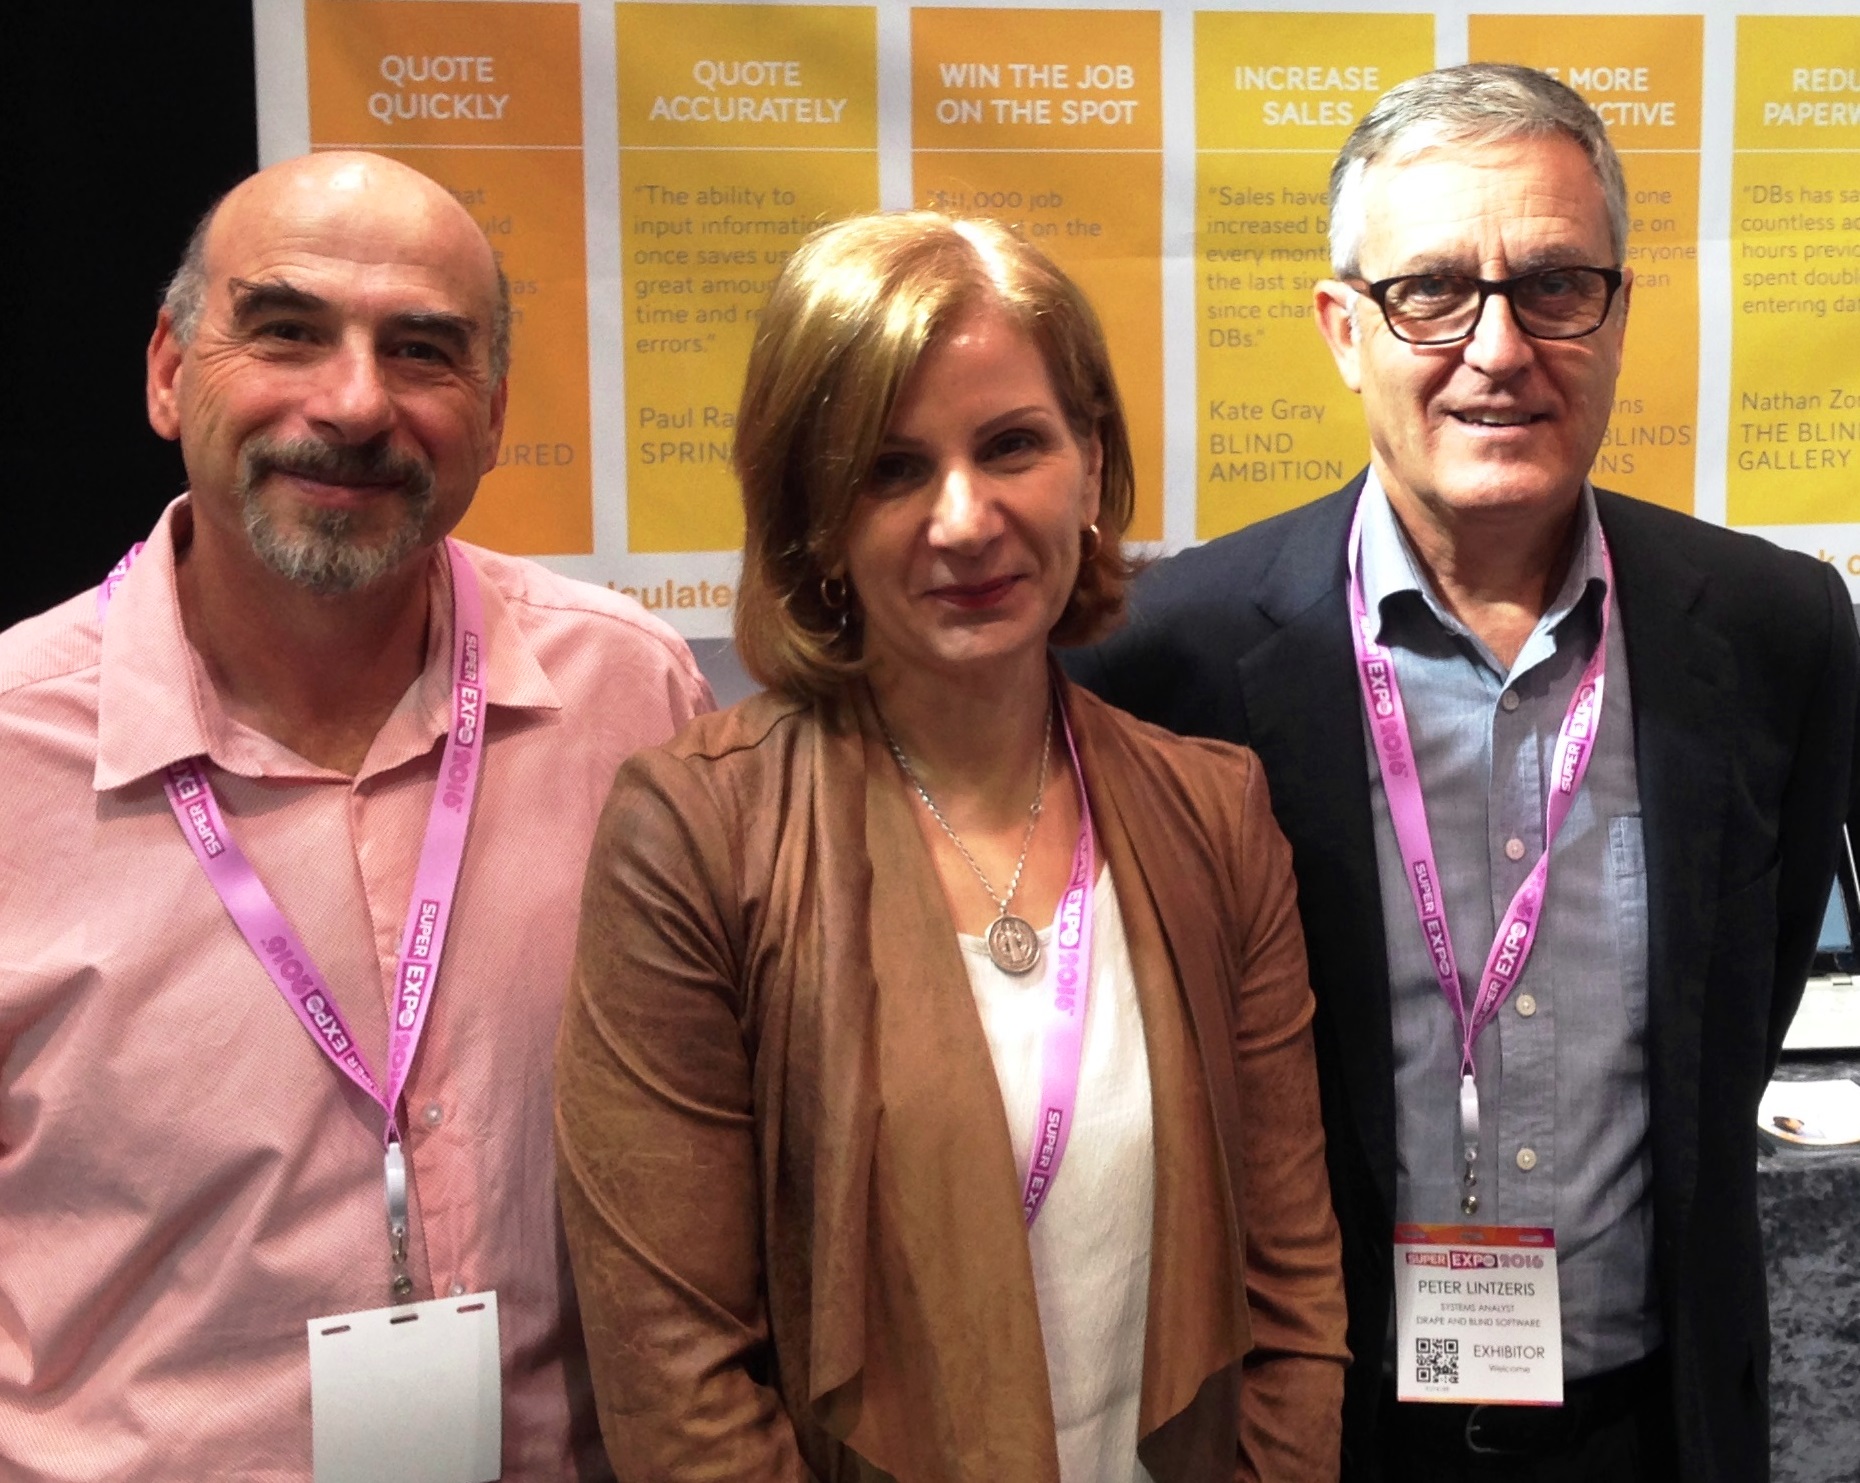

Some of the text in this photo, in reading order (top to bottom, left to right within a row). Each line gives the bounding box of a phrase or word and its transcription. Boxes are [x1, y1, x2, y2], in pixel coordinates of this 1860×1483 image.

[379, 55, 496, 87] QUOTE
[693, 60, 802, 91] QUOTE
[939, 63, 1134, 89] WIN THE JOB
[1235, 66, 1379, 91] INCREASE
[1569, 67, 1649, 91] MORE
[368, 93, 509, 124] QUICKLY
[650, 96, 847, 123] ACCURATELY
[936, 99, 1138, 125] ON THE SPOT
[1262, 101, 1354, 126] SALES
[1589, 101, 1676, 127] CTIVE
[696, 186, 766, 209] ability
[772, 187, 795, 205] to
[1029, 191, 1063, 212] job
[1282, 186, 1329, 206] have
[1635, 190, 1672, 204] one
[1800, 185, 1834, 204] has
[634, 215, 829, 239] input informatio
[1032, 223, 1058, 237] on
[1066, 218, 1101, 237] the
[1207, 215, 1308, 235] increased
[1651, 218, 1675, 232] on
[1741, 214, 1836, 232] countless
[635, 250, 688, 265] once
[698, 250, 757, 265] saves
[1206, 247, 1264, 266] every
[1743, 243, 1797, 259] hours
[635, 278, 775, 298] great amou
[1208, 271, 1318, 291] the last six
[1635, 273, 1670, 288] can
[1743, 270, 1797, 288] spent
[636, 306, 688, 323] time
[696, 305, 737, 323] and
[1208, 300, 1261, 320] since
[1743, 298, 1827, 318] entering
[1210, 399, 1326, 424] Kate Gray
[1741, 391, 1821, 412] Nathan
[640, 407, 692, 429] Paul
[1740, 422, 1860, 443] THE BLIN
[641, 442, 735, 464] SPRIN
[1210, 433, 1294, 455] BLIND
[1208, 460, 1343, 482] AMBITION
[1738, 449, 1852, 471] GALLERY
[1368, 661, 1394, 716] EXPO
[443, 633, 478, 809] SUPER EXPO 2016
[189, 803, 222, 855] SUPER
[1060, 887, 1085, 947] EXPO
[1414, 862, 1451, 976] SUPER EXPO
[413, 902, 437, 959] SUPER
[1495, 921, 1528, 977] EXPO
[398, 964, 427, 1028] EXPO
[306, 993, 350, 1053] EXPO
[1039, 1110, 1060, 1168] SUPER
[1407, 1252, 1544, 1269] SUPER EXPO 2016
[1418, 1280, 1535, 1296] PETER LINTZERIS
[1440, 1303, 1514, 1312] SYSTEMS ANALYST
[1416, 1316, 1541, 1328] DRAPE AND BLIND SOFTWARE
[1473, 1344, 1545, 1359] EXHIBITOR
[1489, 1364, 1531, 1374] Welcome
